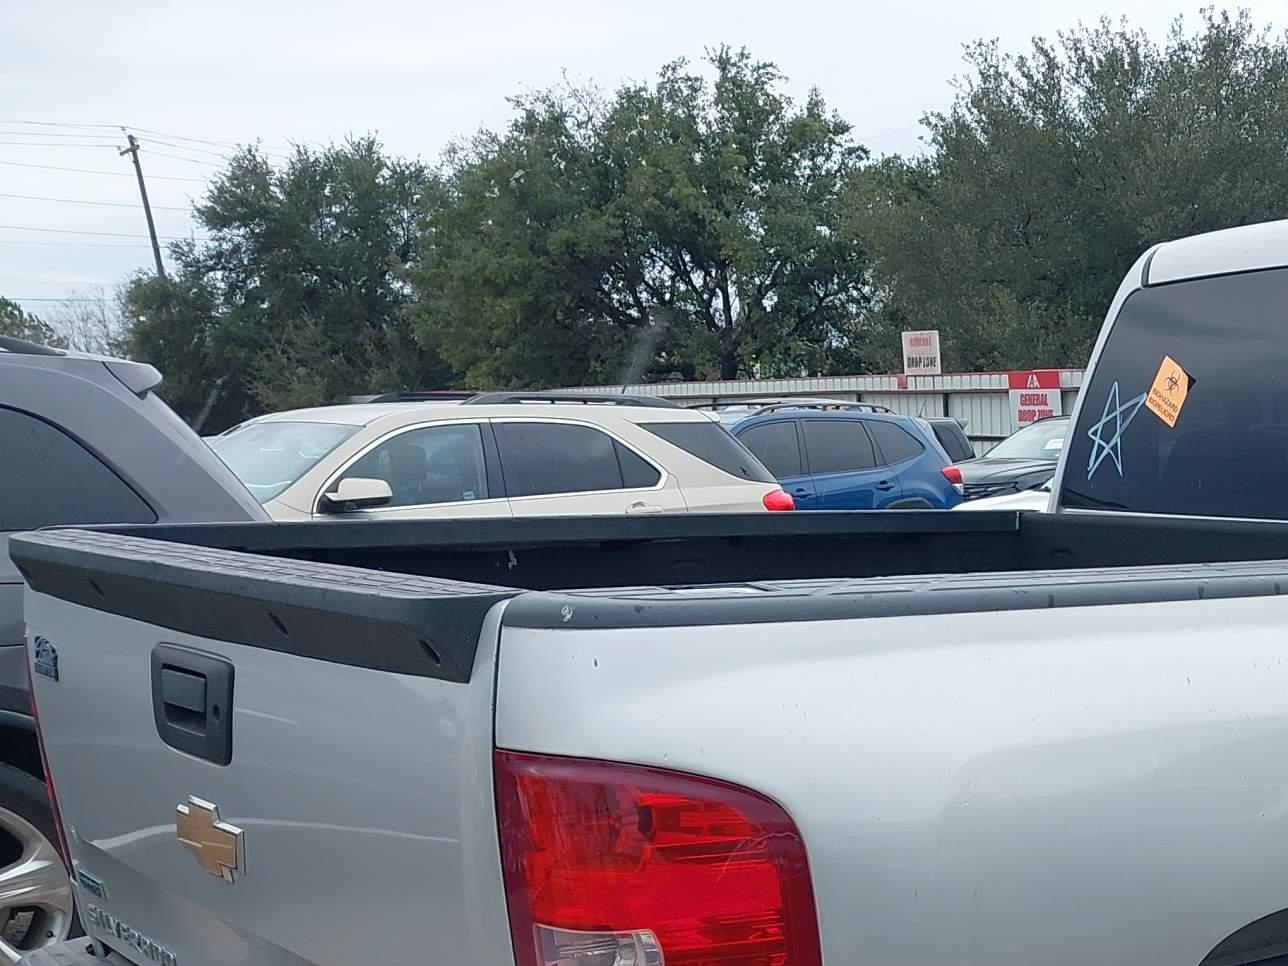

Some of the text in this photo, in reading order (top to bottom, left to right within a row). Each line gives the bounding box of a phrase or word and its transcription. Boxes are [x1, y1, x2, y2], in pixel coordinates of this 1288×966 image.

[907, 356, 937, 369] DROP ZONE
[1019, 393, 1049, 406] GENERAL
[1018, 410, 1037, 422] DROP
